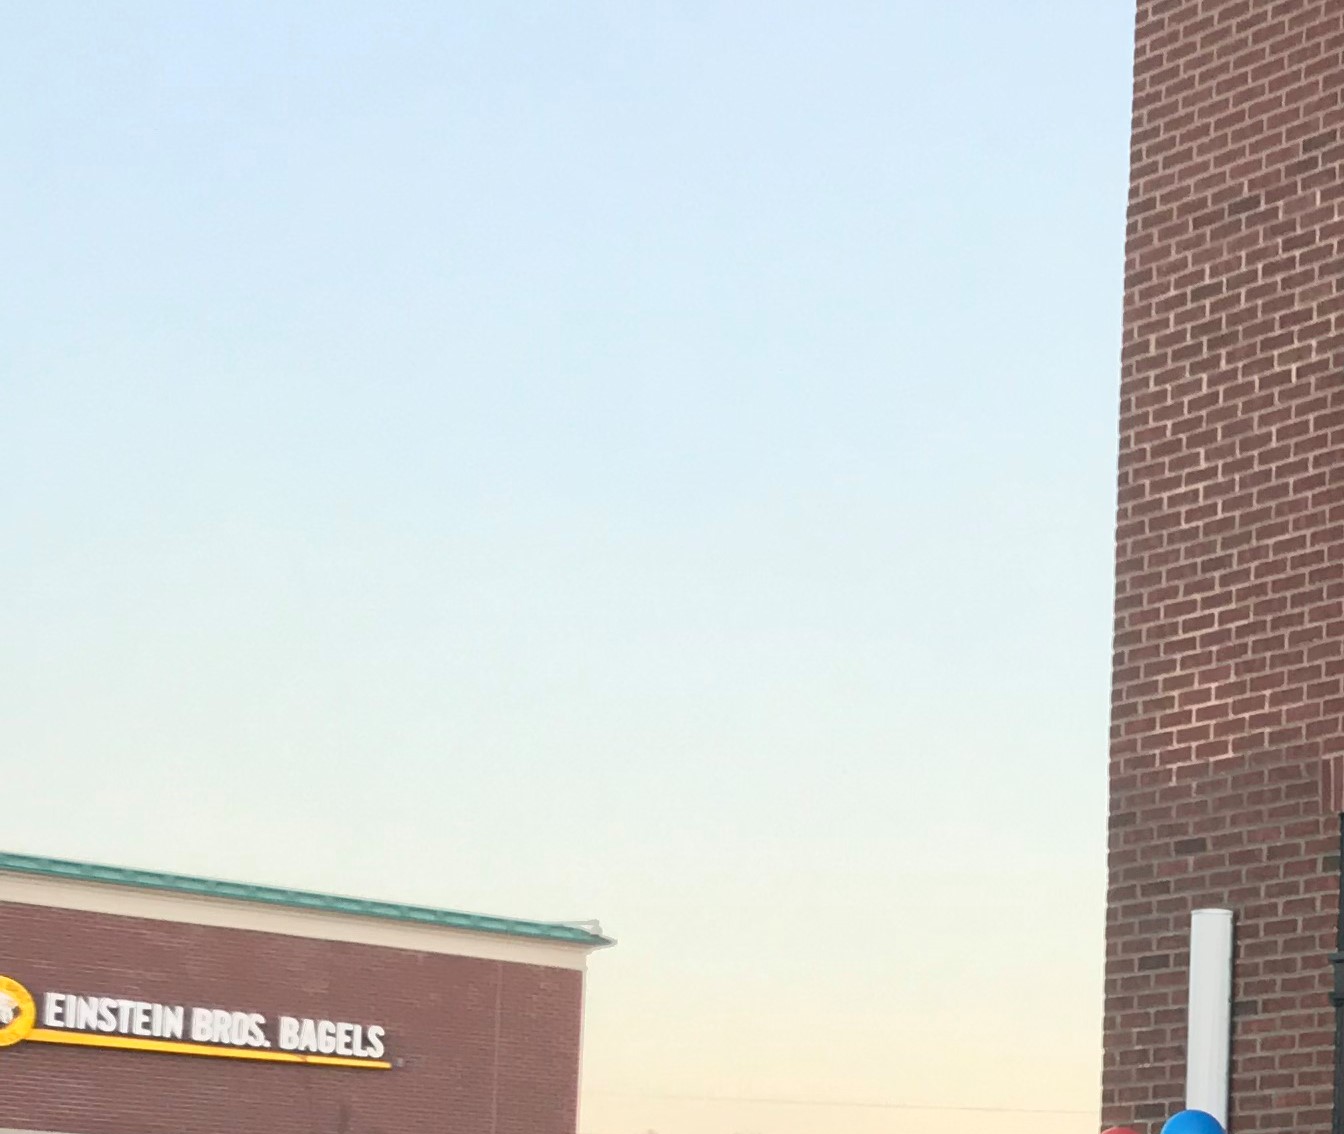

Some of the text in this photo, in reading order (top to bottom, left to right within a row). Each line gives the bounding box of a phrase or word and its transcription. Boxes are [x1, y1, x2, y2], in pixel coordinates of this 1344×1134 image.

[43, 991, 386, 1058] EINSTEIN BROS. BAGELS
